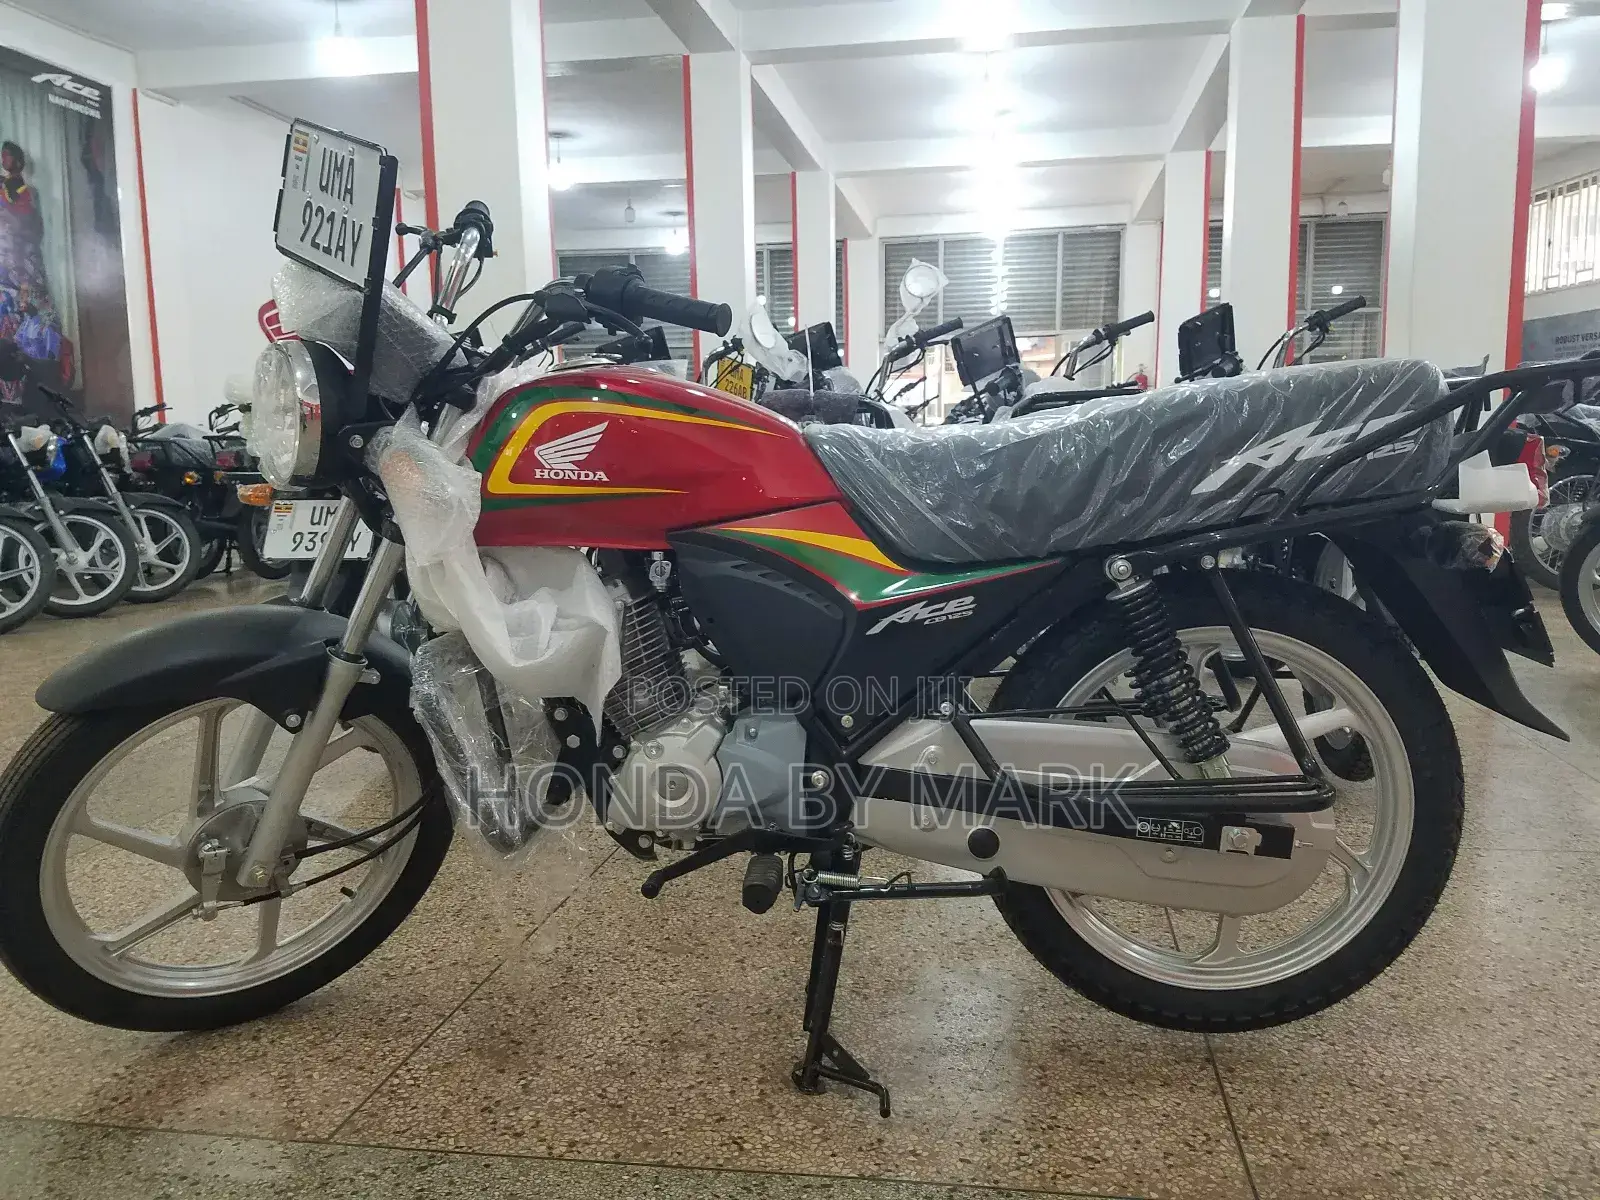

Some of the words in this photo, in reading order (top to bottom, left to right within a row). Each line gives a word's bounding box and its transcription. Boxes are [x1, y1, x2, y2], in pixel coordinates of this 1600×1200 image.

[319, 147, 355, 205] UMA
[300, 200, 363, 267] 921AY
[1555, 334, 1580, 345] ROBUST
[534, 468, 610, 482] HONDA
[310, 505, 339, 526] UM
[291, 531, 362, 552] 93Y
